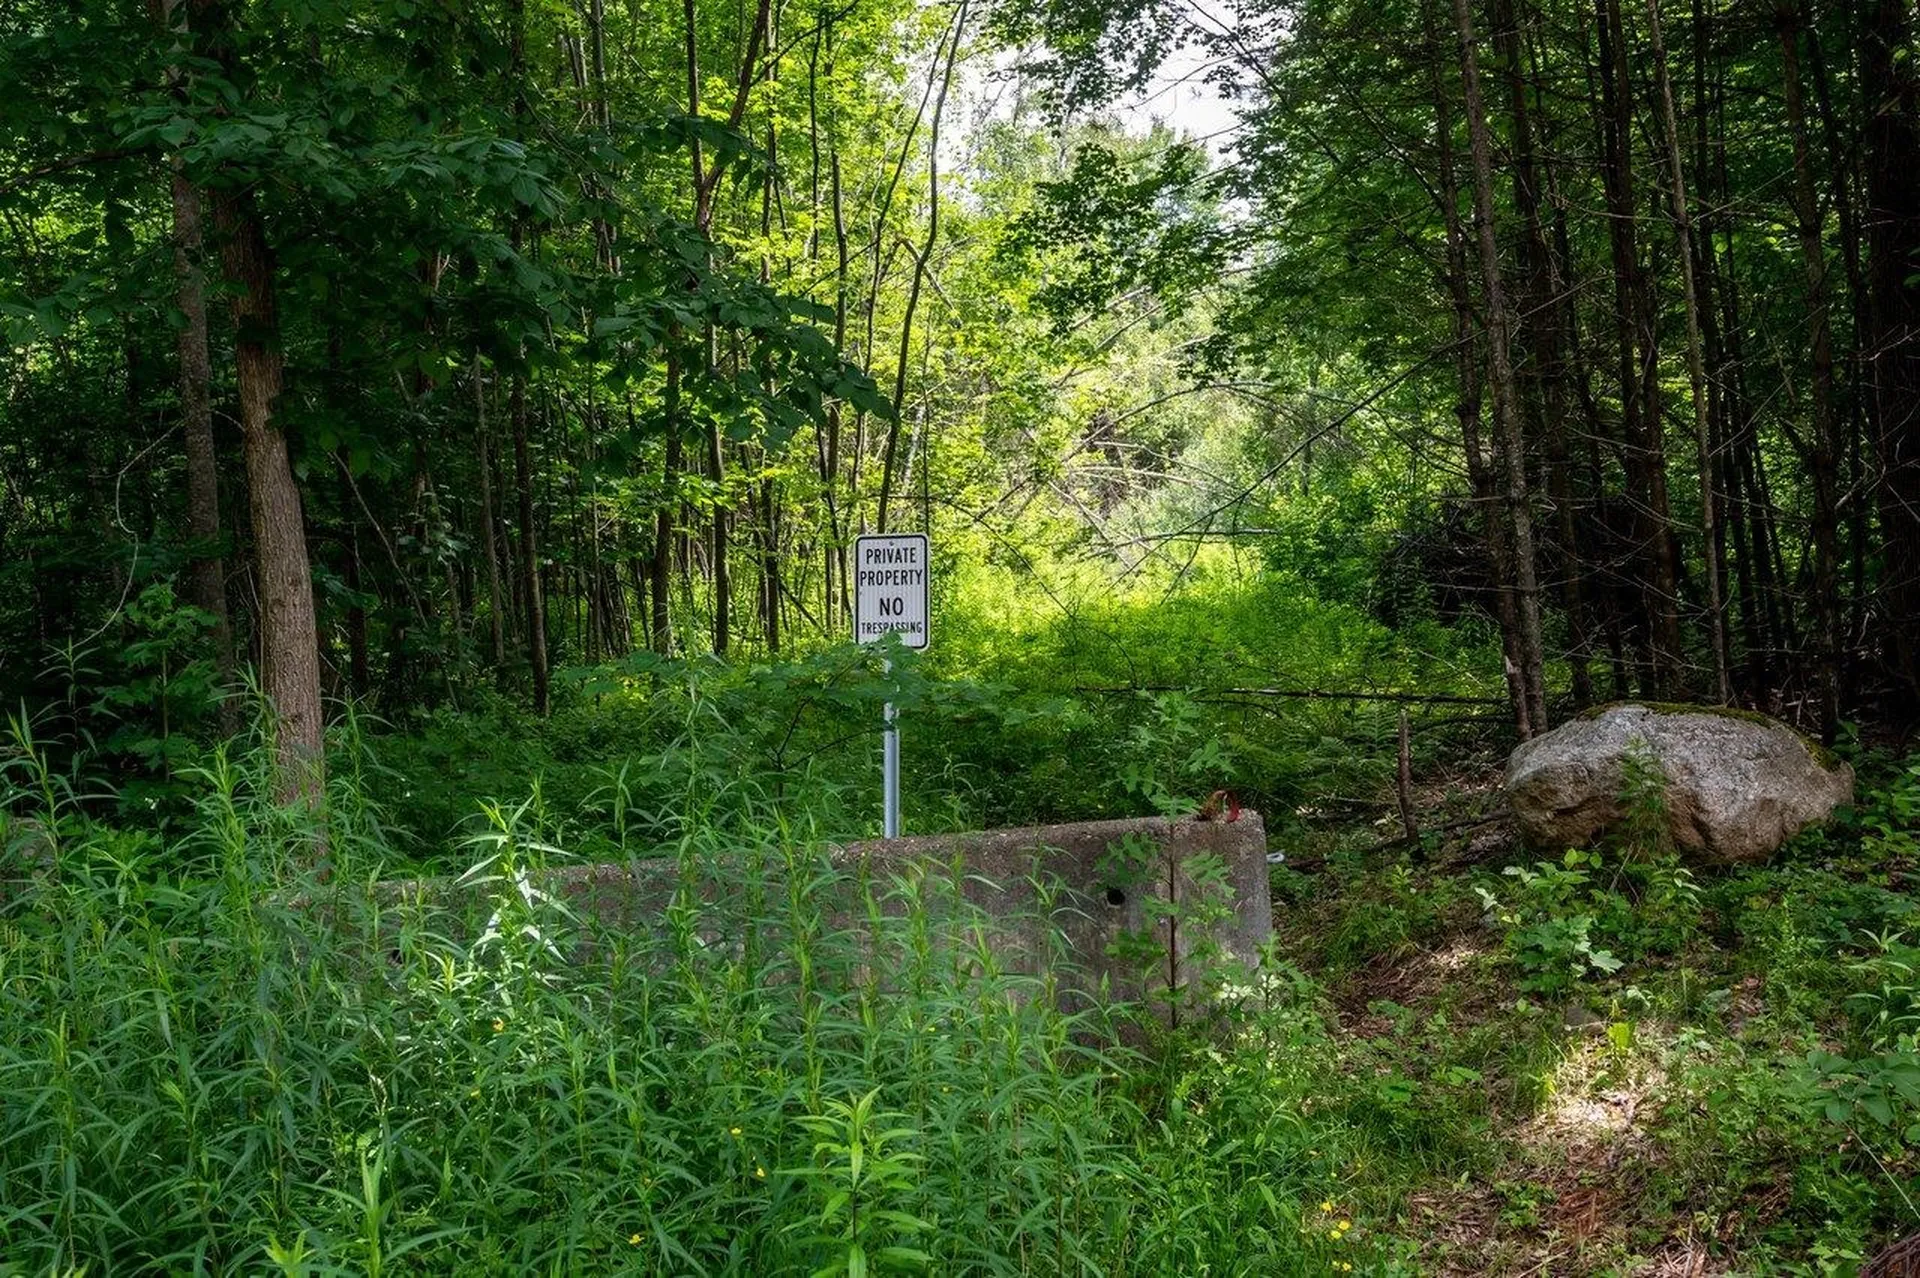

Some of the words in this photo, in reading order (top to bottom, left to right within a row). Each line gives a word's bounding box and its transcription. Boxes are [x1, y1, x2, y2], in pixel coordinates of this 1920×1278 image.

[866, 547, 917, 565] PRIVATE
[860, 569, 923, 586] PROPERTY
[879, 597, 904, 616] NO
